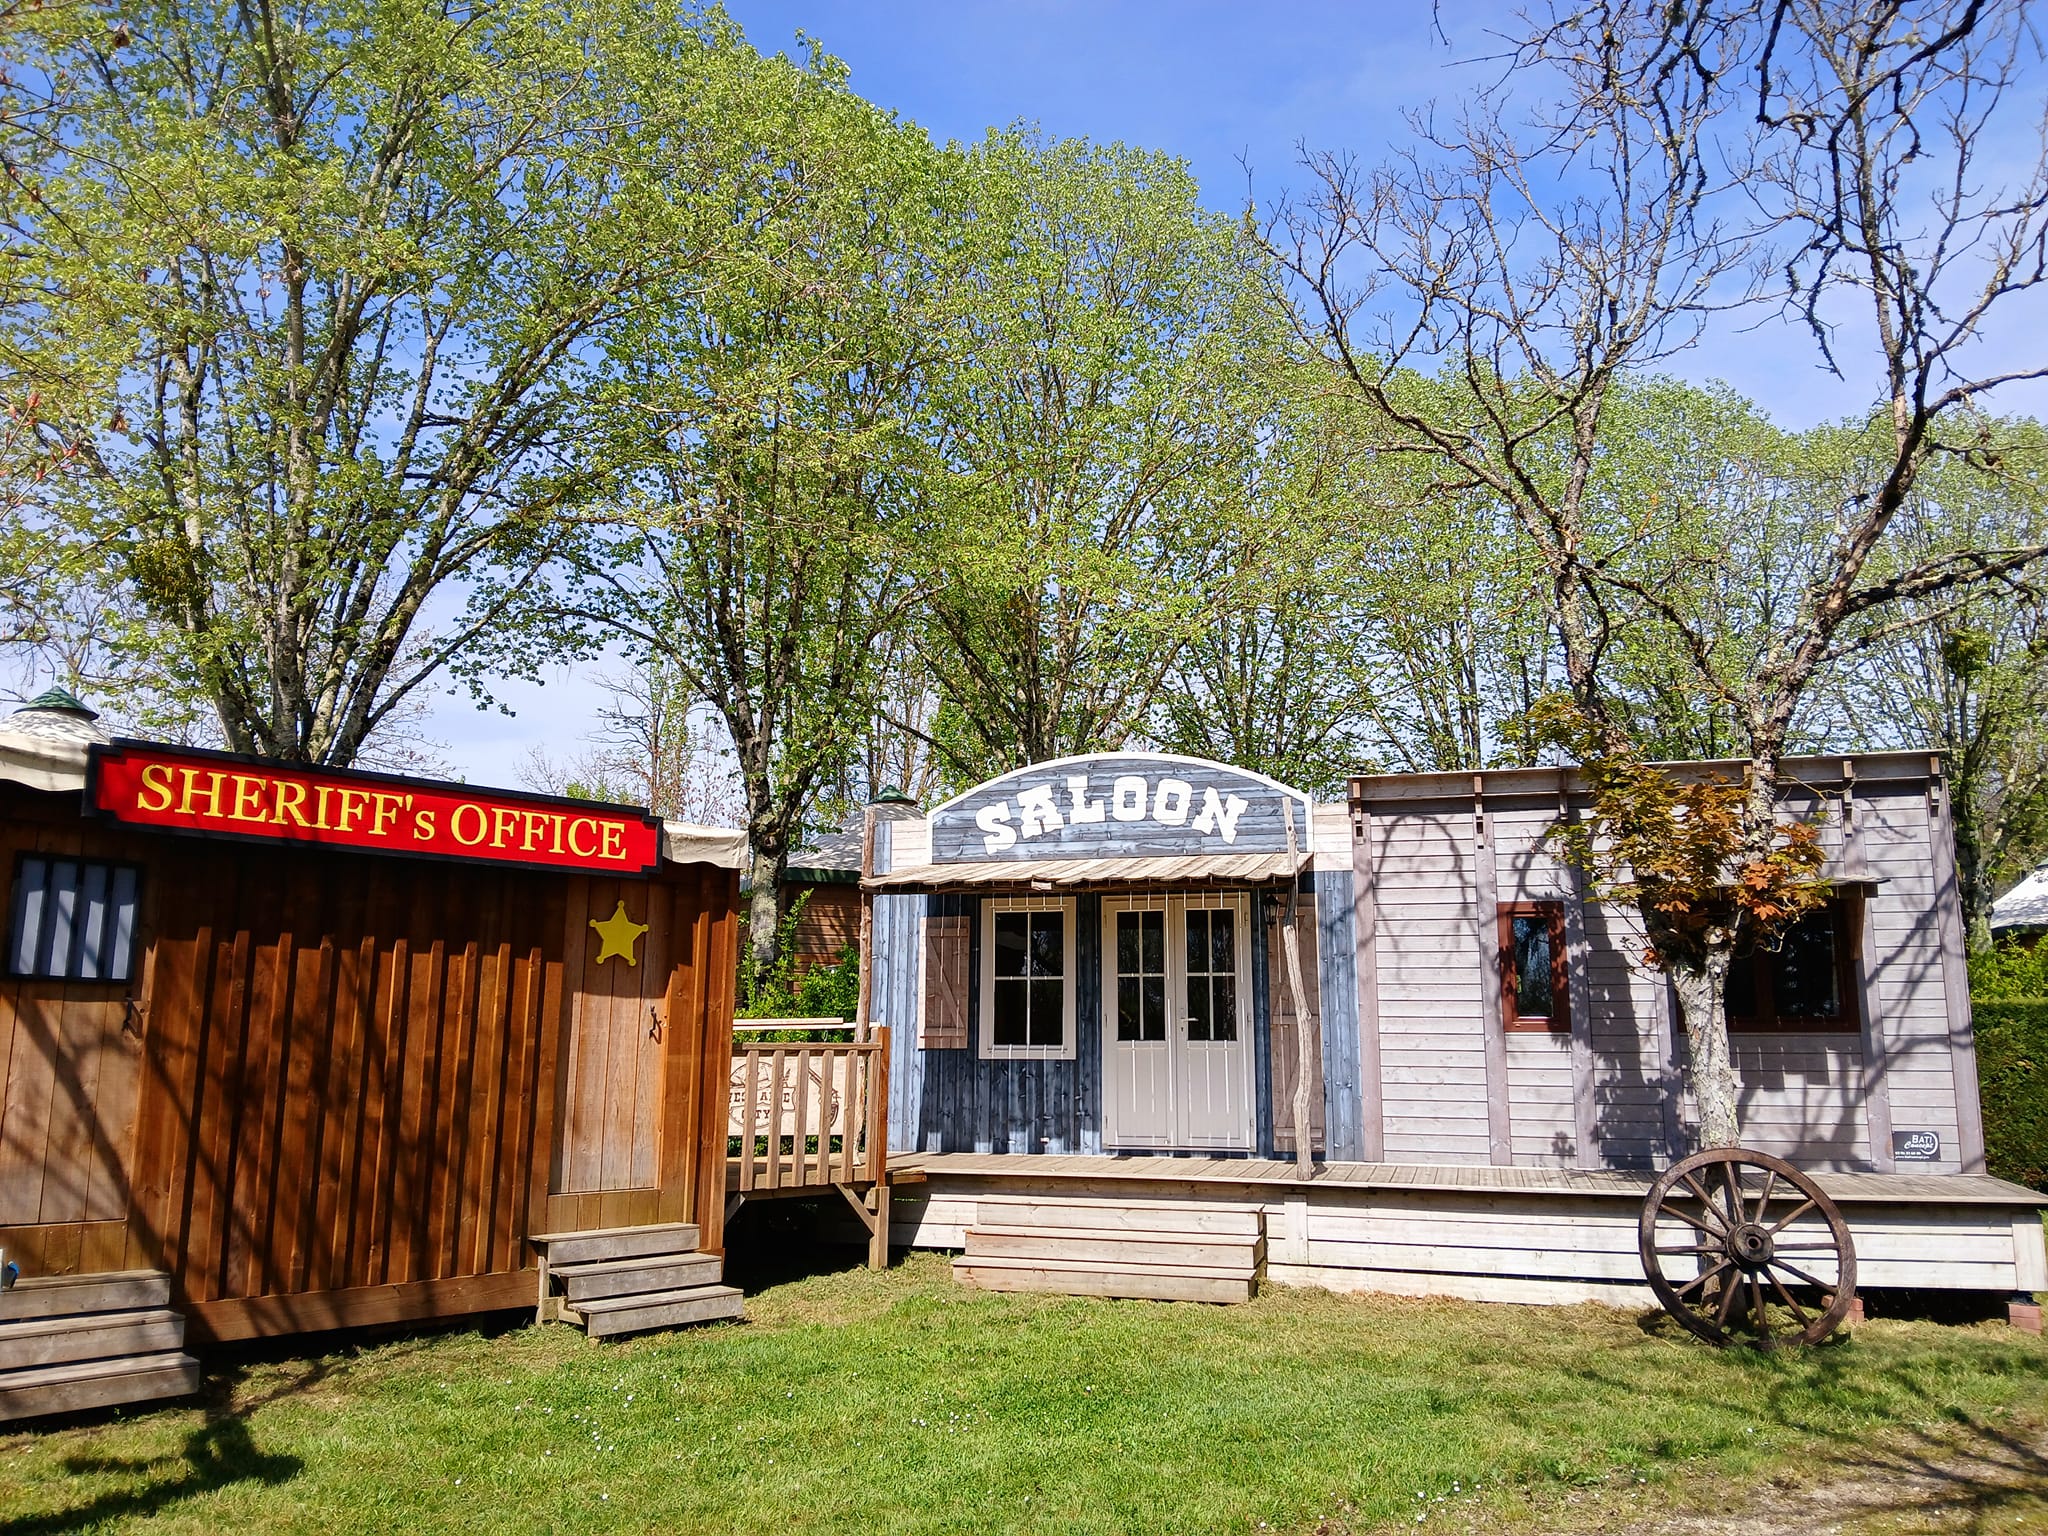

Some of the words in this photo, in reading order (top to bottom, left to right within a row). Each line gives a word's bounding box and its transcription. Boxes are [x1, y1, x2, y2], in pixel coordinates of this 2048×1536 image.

[137, 764, 435, 841] SHERIFF's
[450, 803, 628, 860] OFFICE
[975, 775, 1249, 855] SALOON
[1912, 1134, 1933, 1144] BATI
